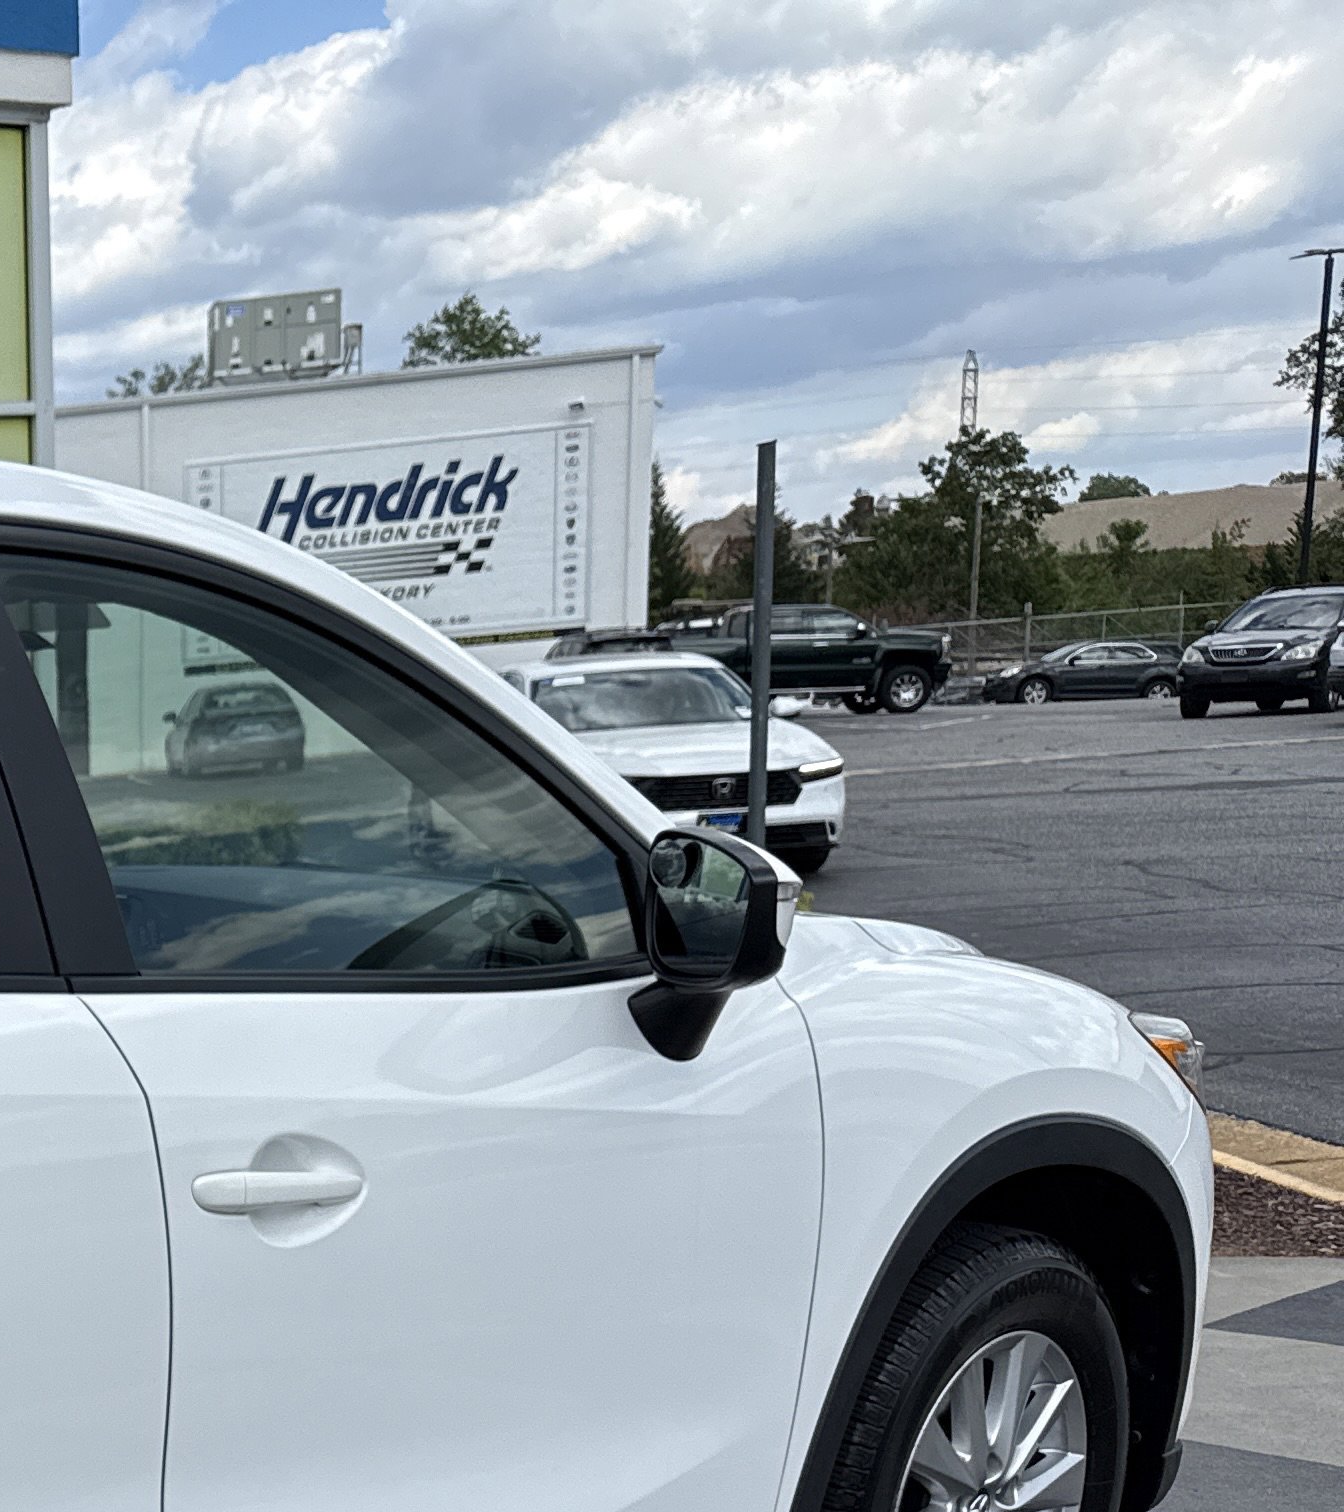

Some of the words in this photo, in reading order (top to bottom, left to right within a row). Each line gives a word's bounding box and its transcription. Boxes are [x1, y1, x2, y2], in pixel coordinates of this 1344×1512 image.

[258, 454, 519, 543] Hendrick
[298, 525, 411, 551] COLLISION
[415, 516, 501, 540] CENTER
